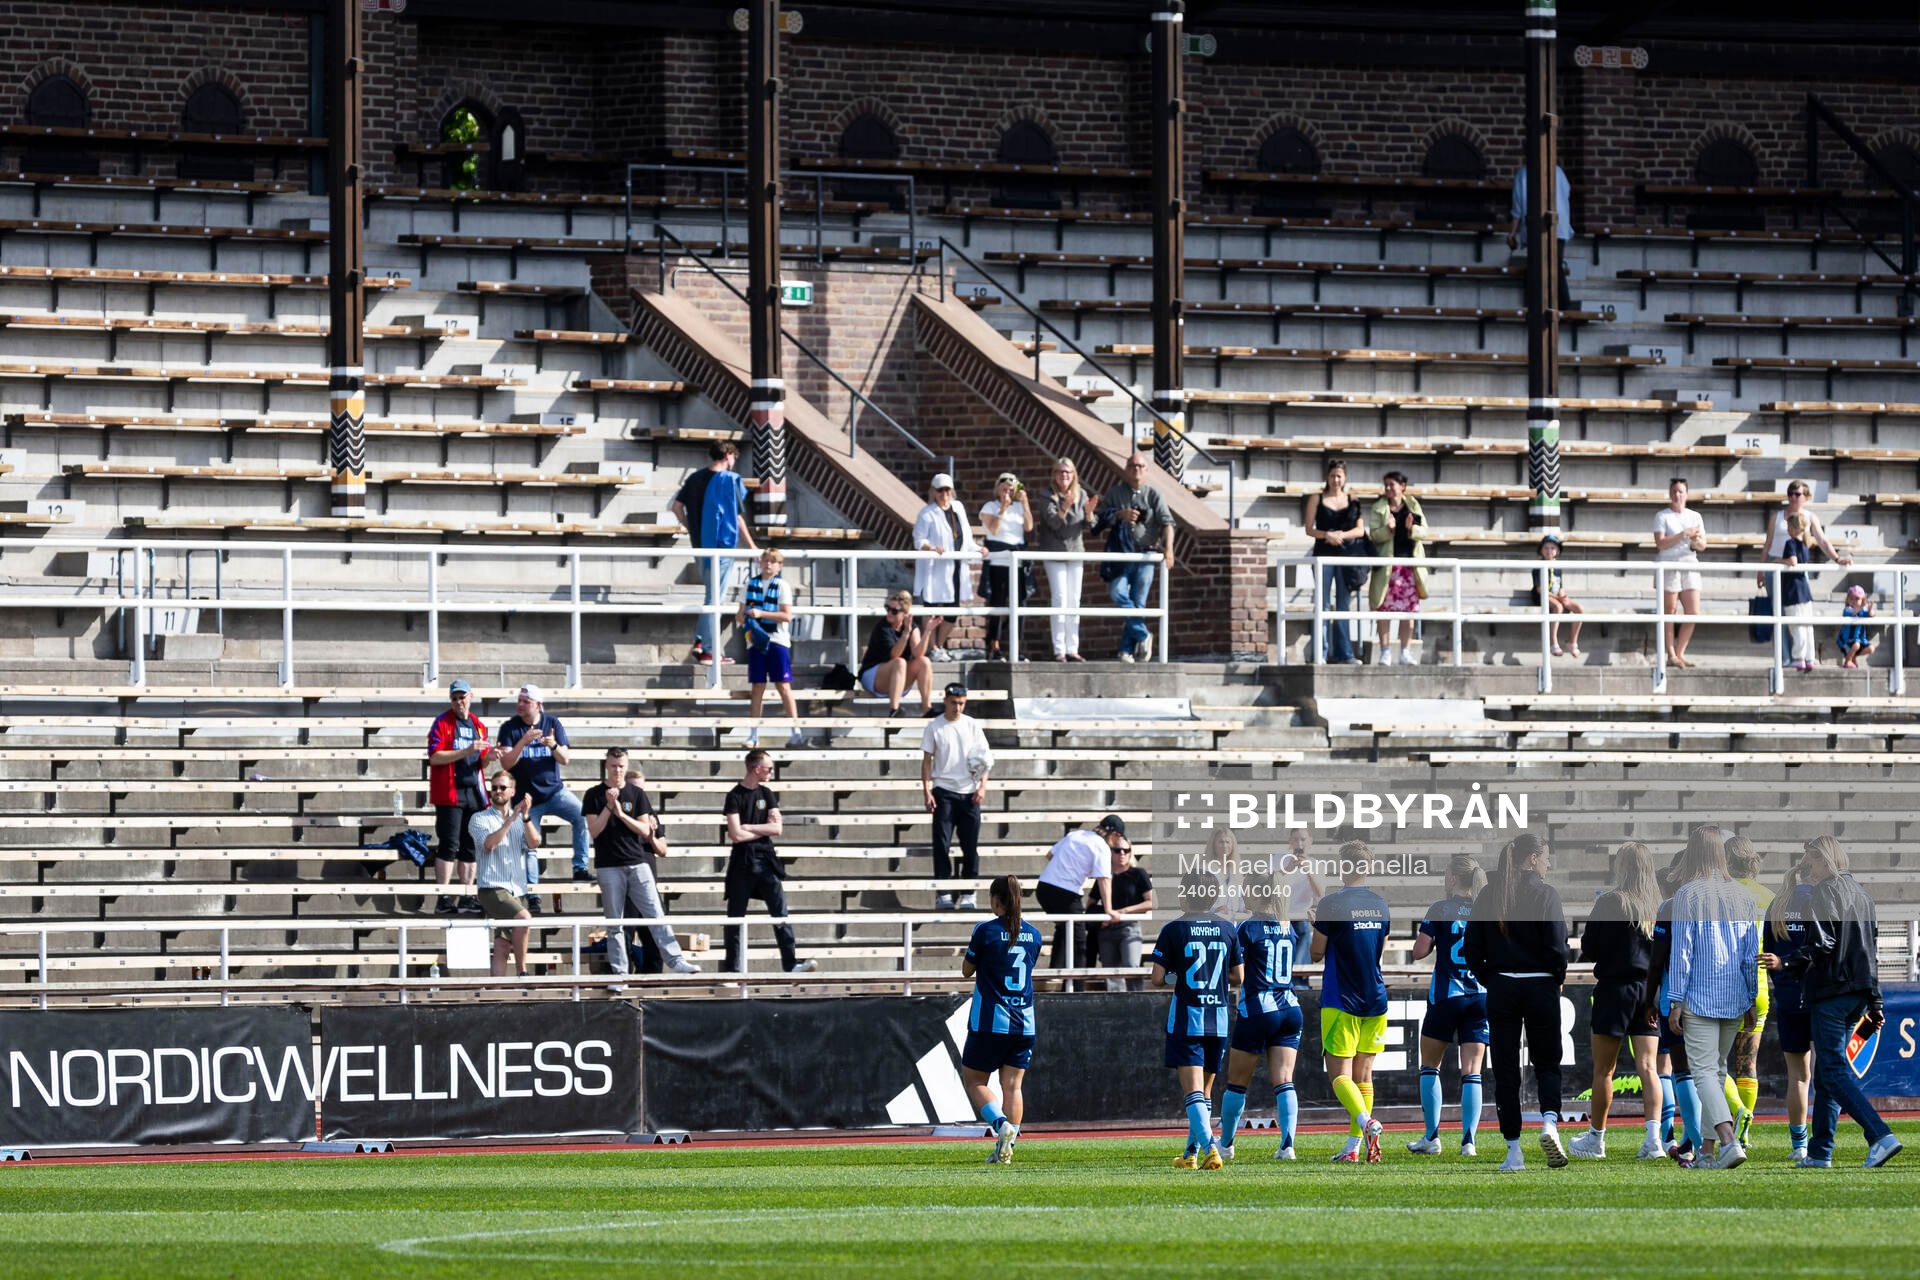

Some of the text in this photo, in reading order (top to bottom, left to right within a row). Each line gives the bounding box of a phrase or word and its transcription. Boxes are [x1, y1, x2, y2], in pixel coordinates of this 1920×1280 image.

[165, 611, 175, 631] 11
[1190, 926, 1221, 937] KOYAMA
[1004, 945, 1027, 992] 3
[1184, 941, 1228, 990] 27
[1264, 939, 1294, 985] 10
[1001, 996, 1027, 1007] TCL
[1197, 994, 1222, 1005] TCL
